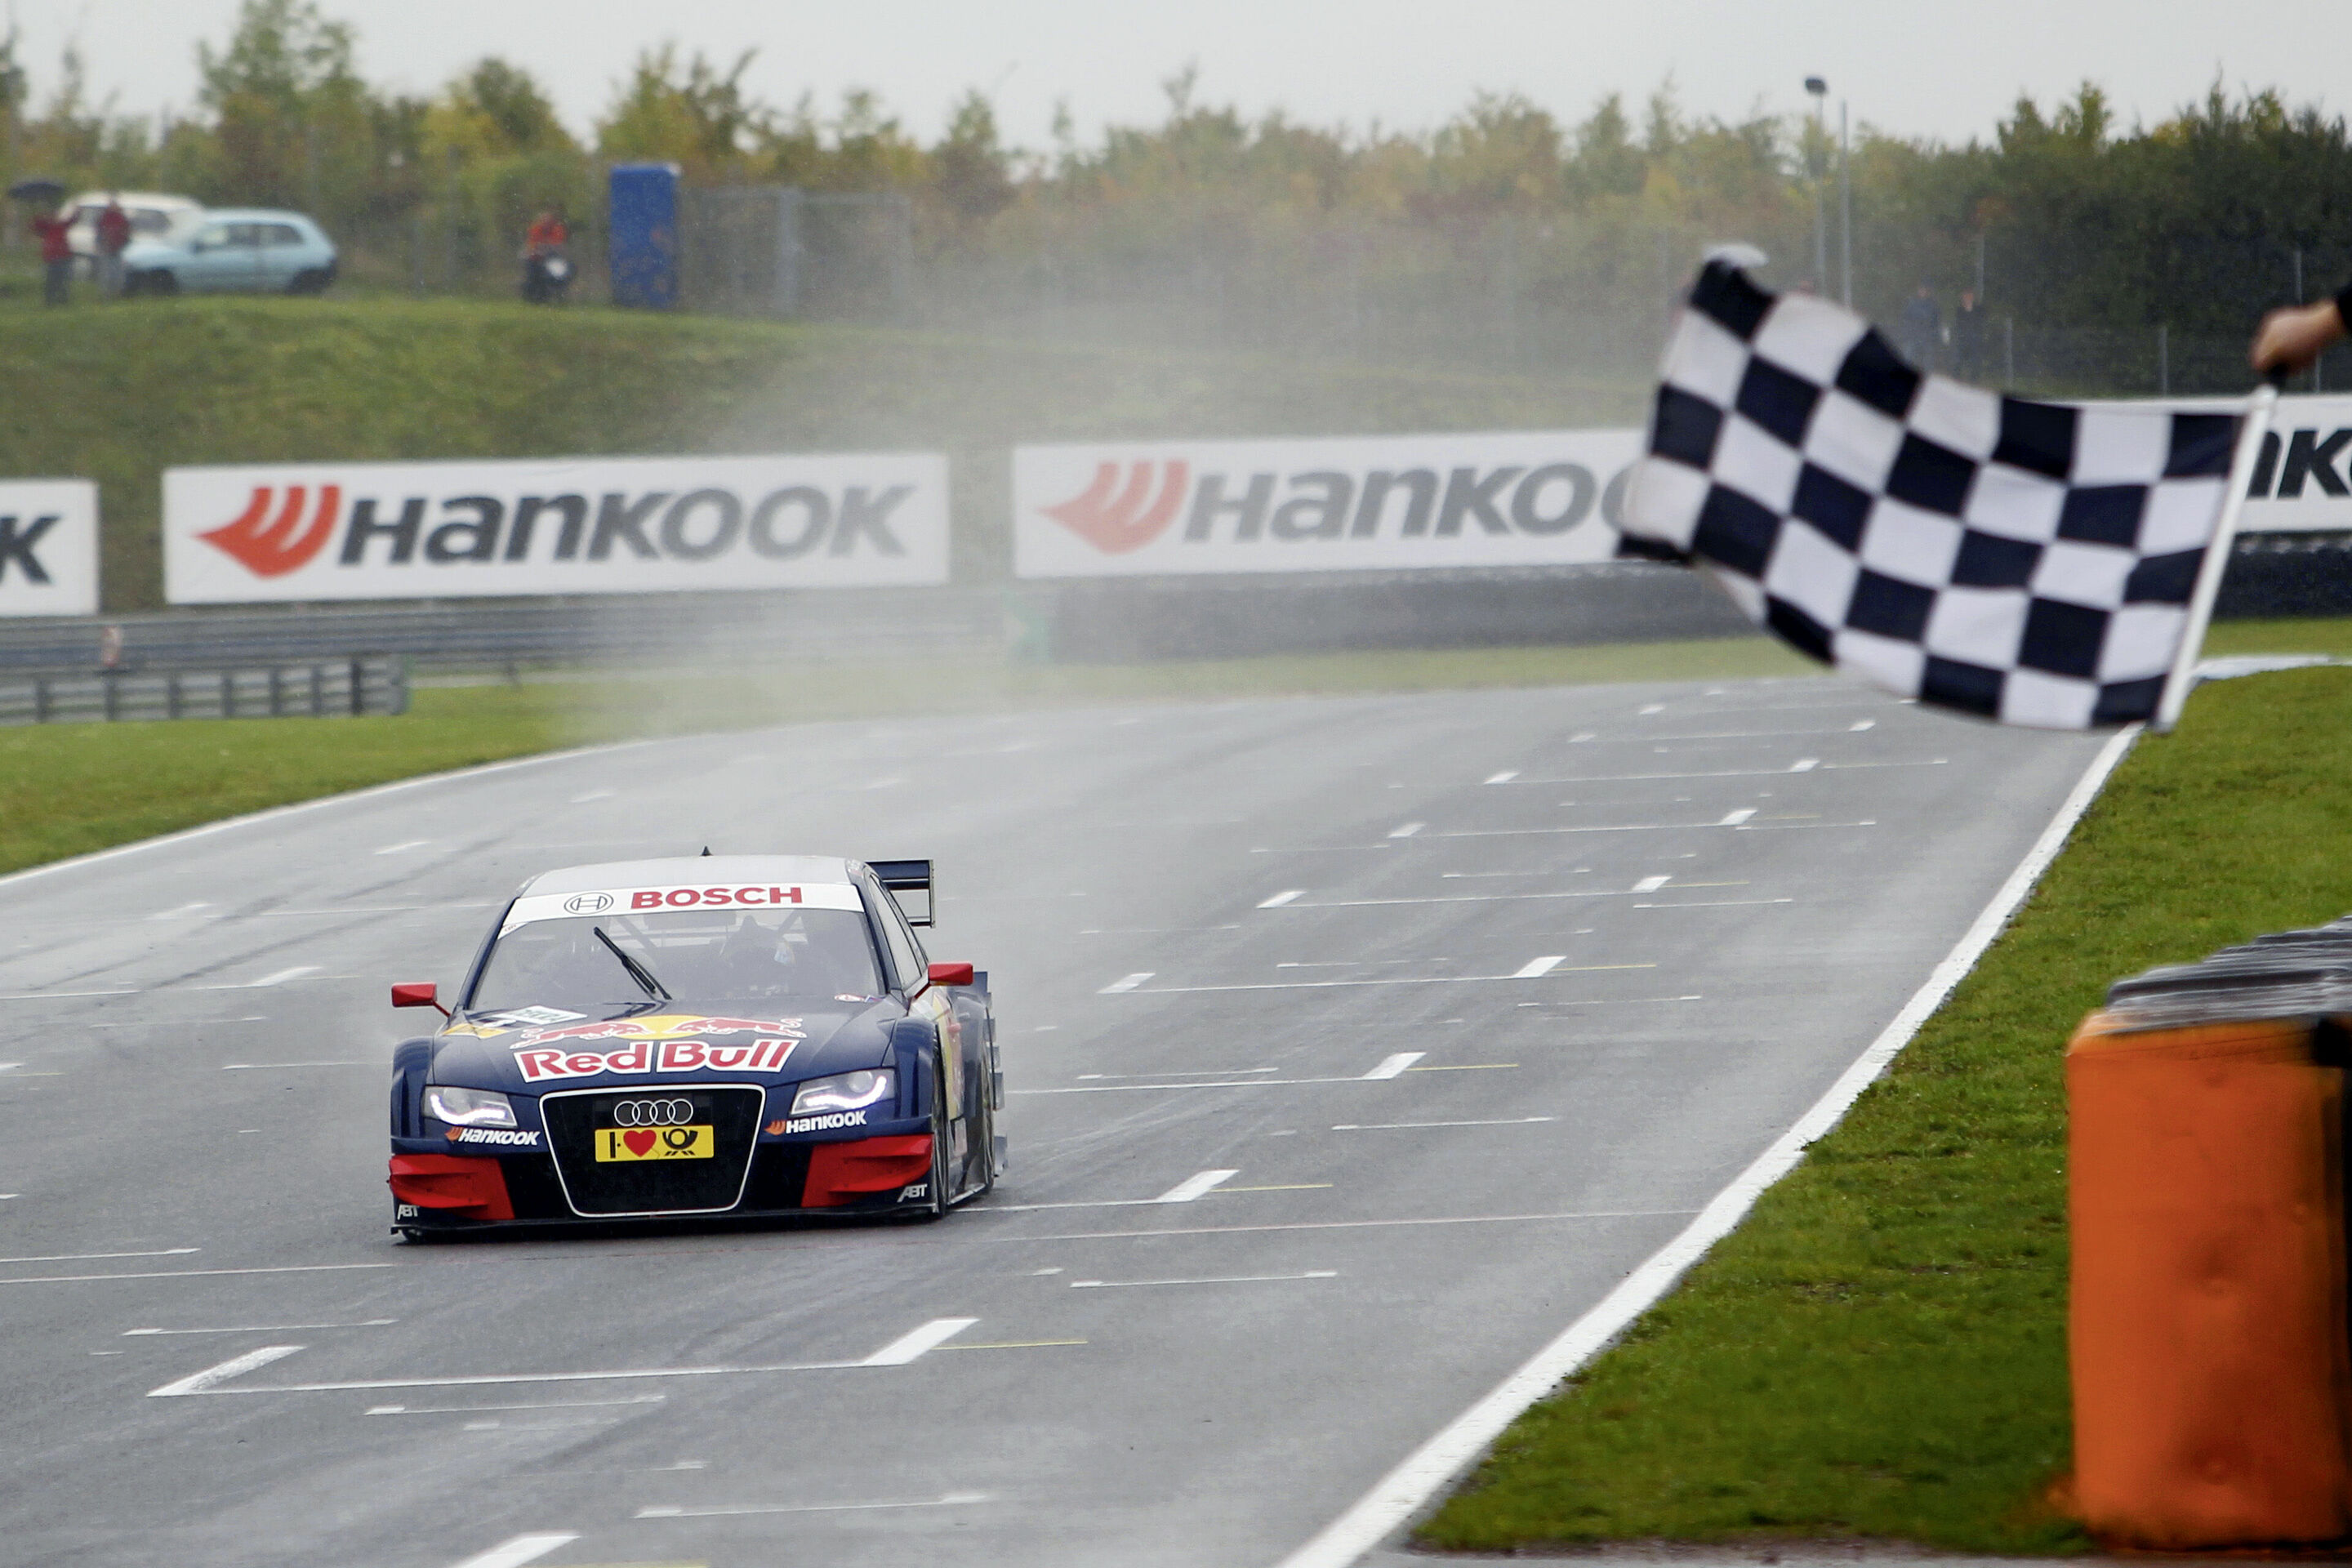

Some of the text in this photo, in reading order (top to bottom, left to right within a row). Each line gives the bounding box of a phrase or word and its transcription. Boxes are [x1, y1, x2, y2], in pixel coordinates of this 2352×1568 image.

[630, 887, 803, 909] BOSCH
[519, 1040, 795, 1079] Red Bull
[897, 1183, 928, 1202] ABT
[397, 1204, 419, 1220] ABT
